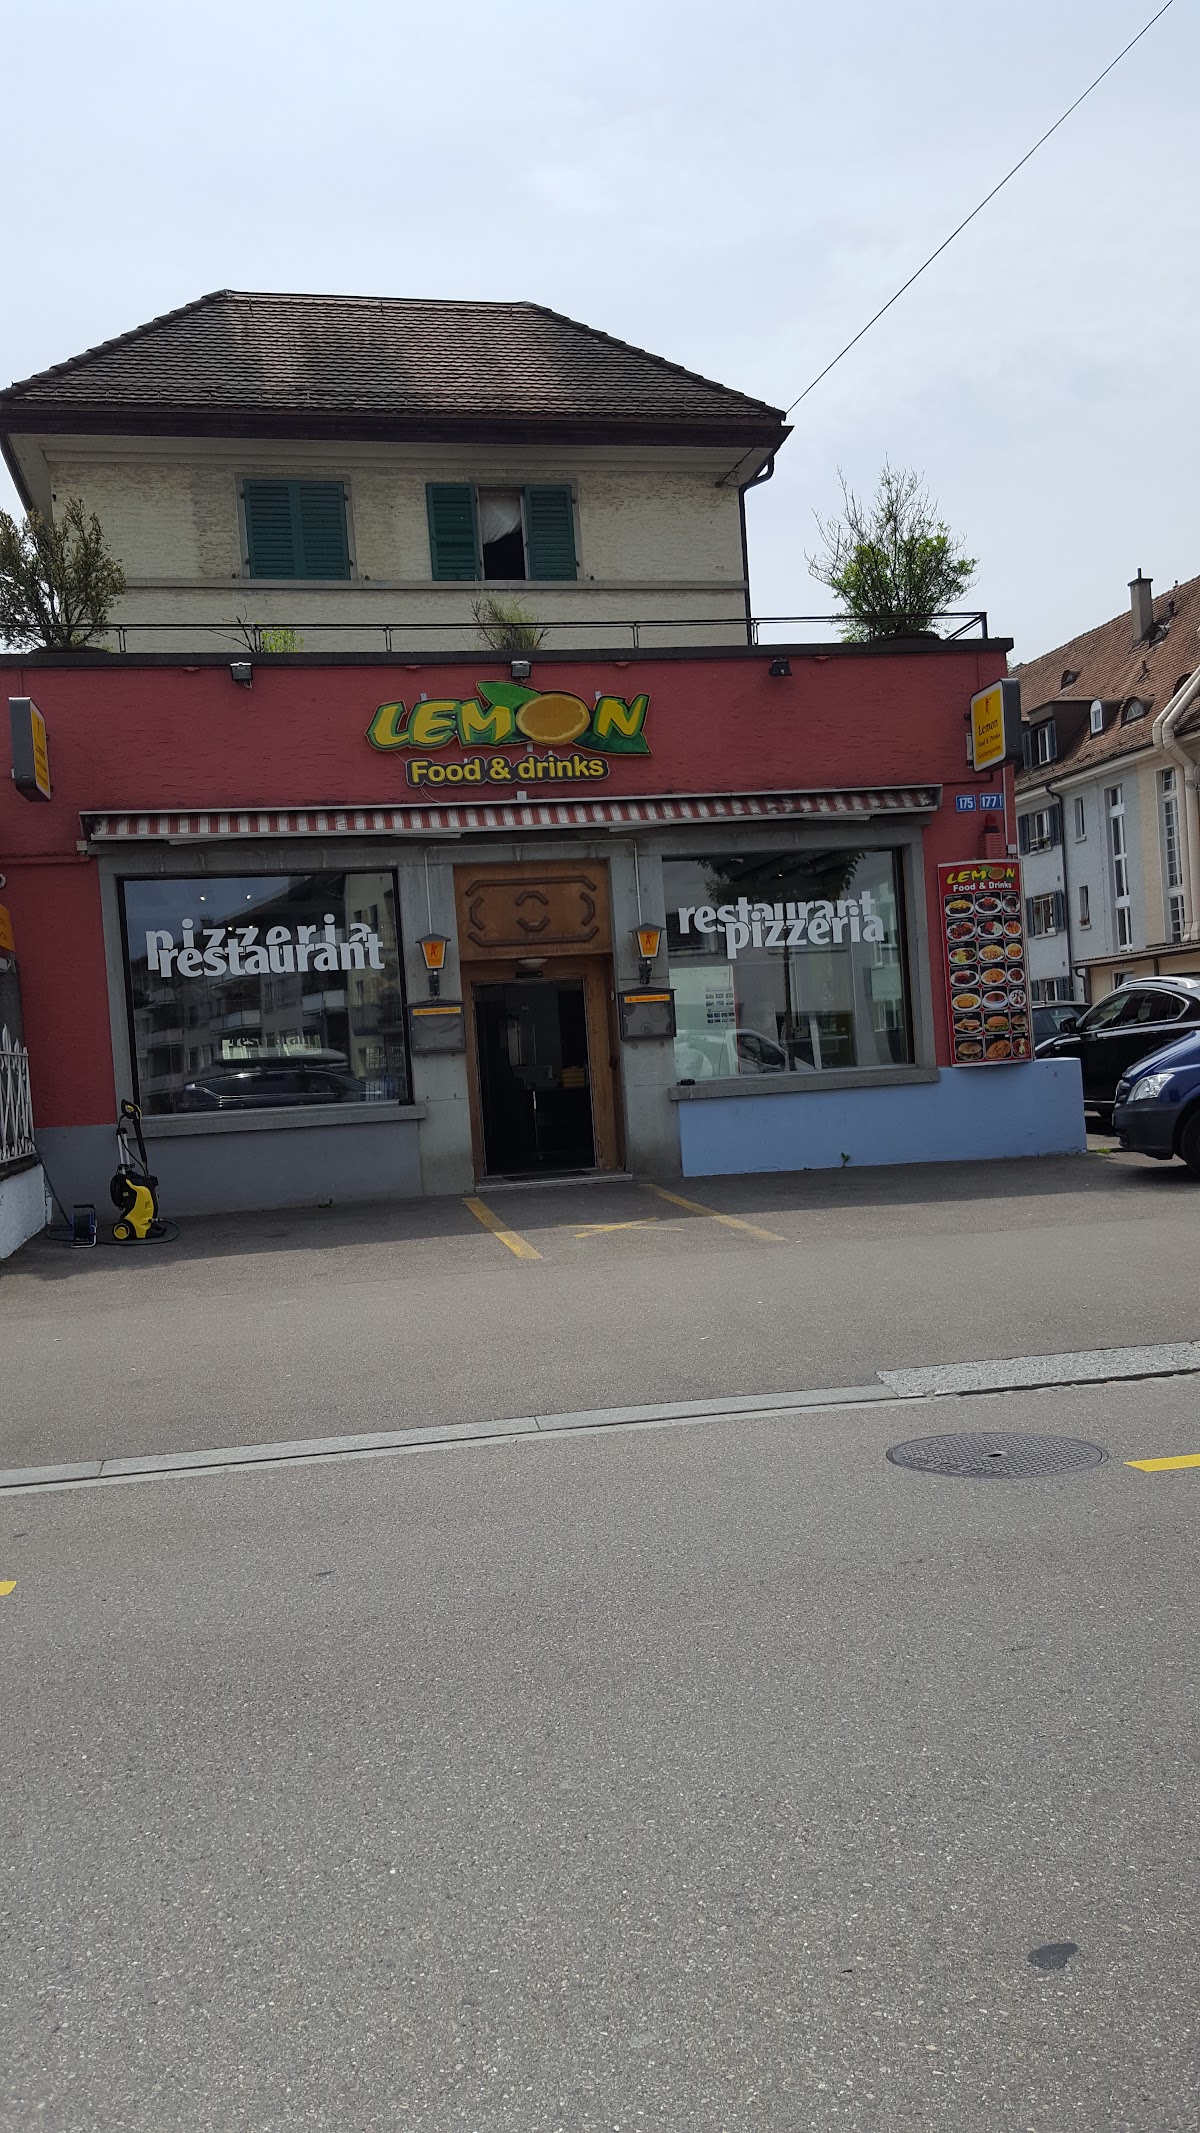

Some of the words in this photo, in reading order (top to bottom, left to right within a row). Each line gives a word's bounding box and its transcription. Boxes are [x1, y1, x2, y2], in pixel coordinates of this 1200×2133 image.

[978, 719, 998, 736] Lemon
[411, 759, 481, 783] Food
[489, 756, 511, 779] &
[518, 755, 604, 779] drinks
[959, 797, 974, 809] 175
[981, 796, 997, 808] 177
[953, 882, 976, 892] Food
[978, 881, 986, 890] &
[989, 880, 1012, 890] Drinks
[678, 891, 876, 934] restaurant
[145, 913, 373, 971] pizzeria
[725, 905, 885, 960] pizzeria
[158, 933, 385, 978] restaurant
